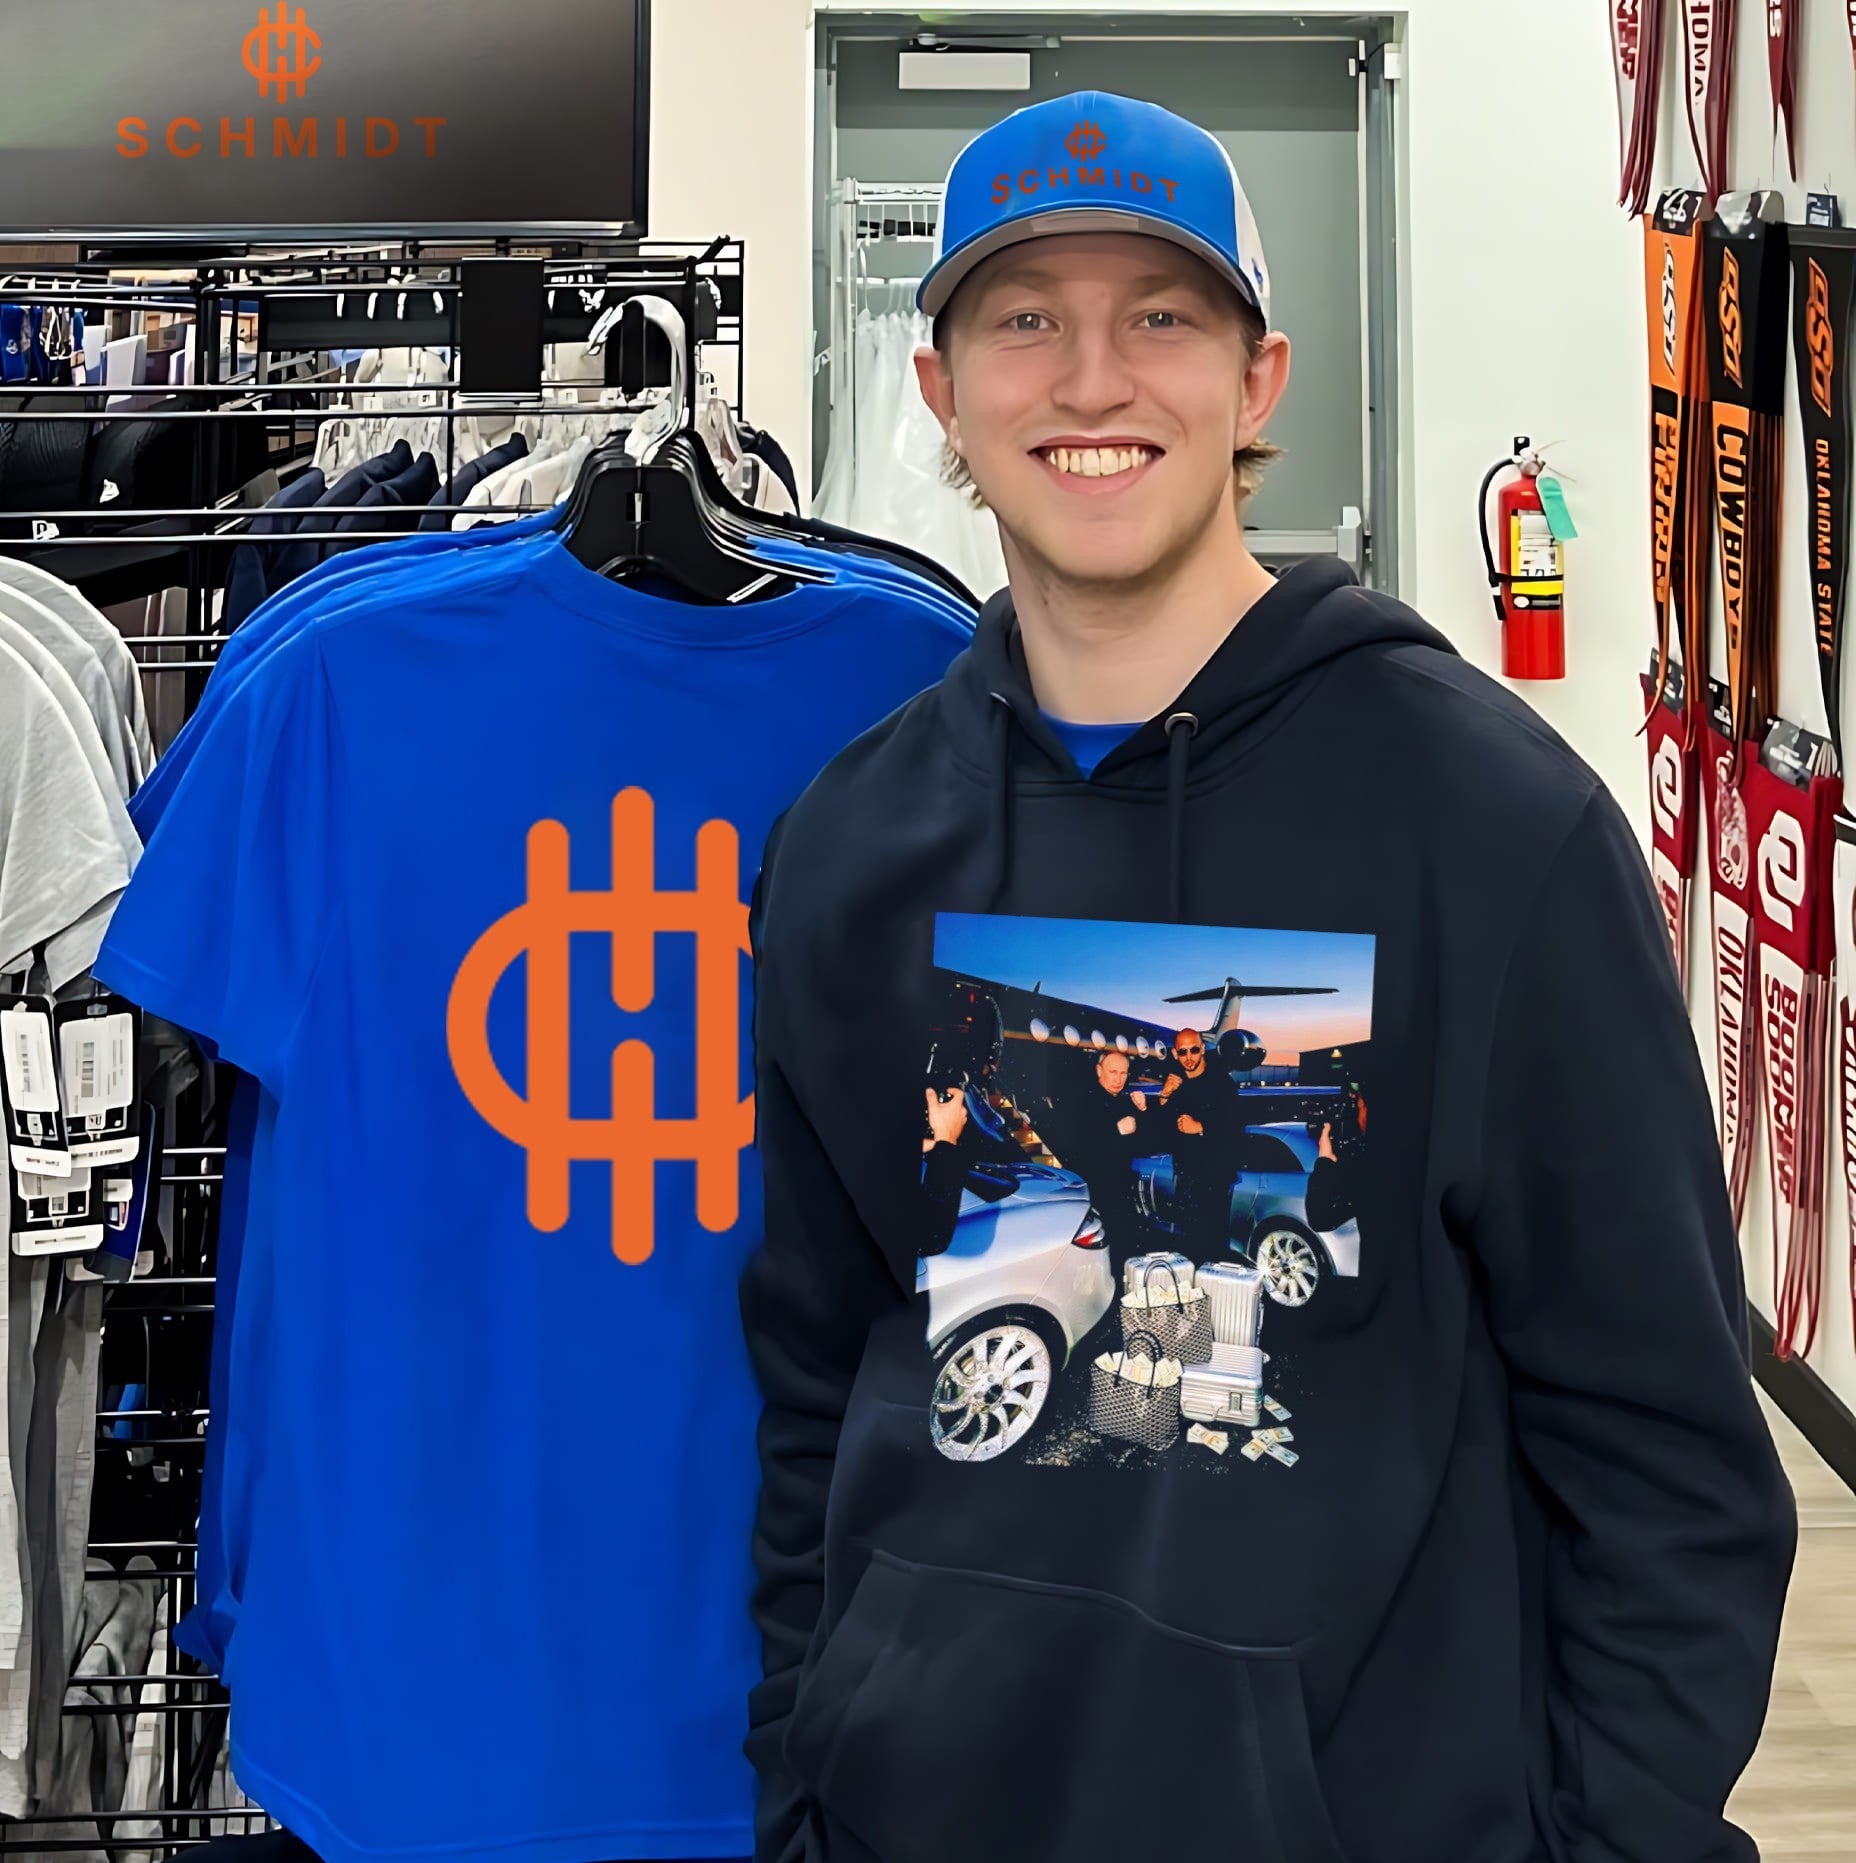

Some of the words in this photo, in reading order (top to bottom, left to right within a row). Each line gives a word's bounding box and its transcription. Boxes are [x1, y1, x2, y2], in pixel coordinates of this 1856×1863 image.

[116, 117, 447, 158] SCHMIDT
[991, 167, 1179, 205] SCHMIDT
[1815, 438, 1833, 570] OKLAHOMA
[1717, 926, 1745, 1144] OKLAHOMA
